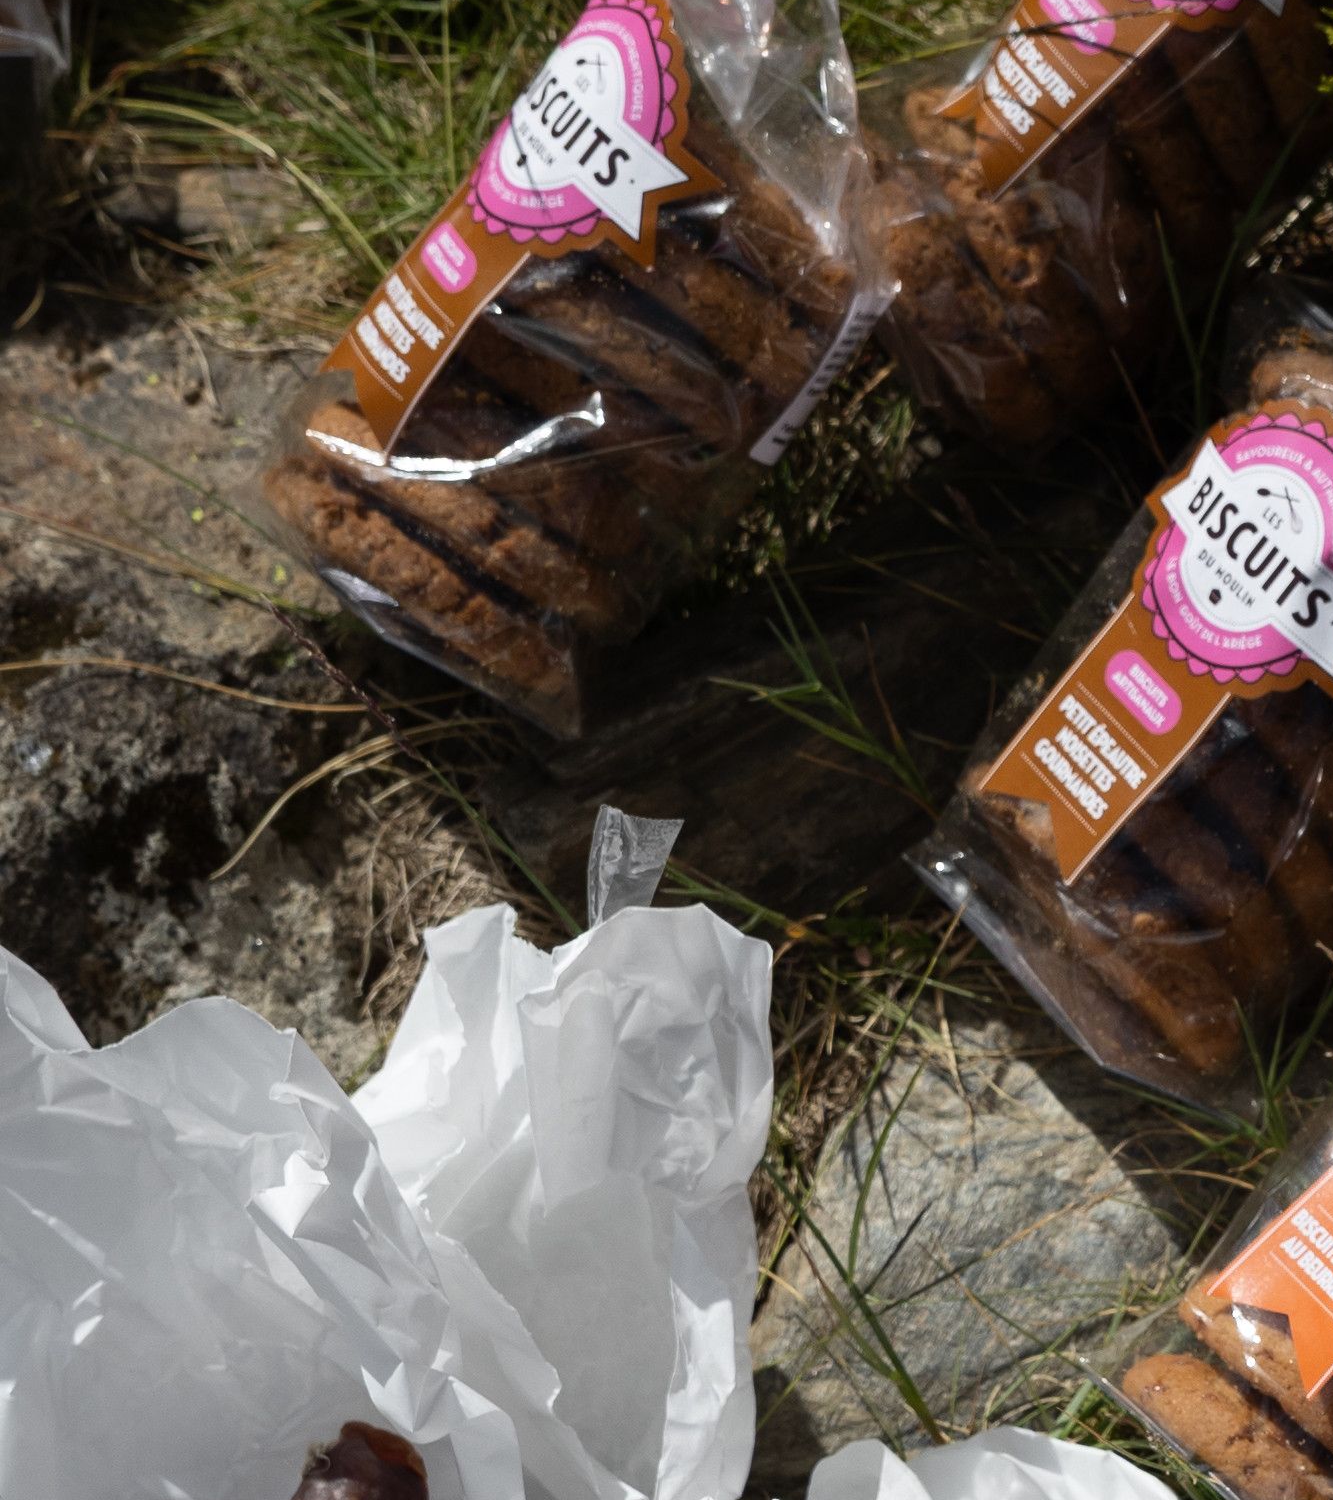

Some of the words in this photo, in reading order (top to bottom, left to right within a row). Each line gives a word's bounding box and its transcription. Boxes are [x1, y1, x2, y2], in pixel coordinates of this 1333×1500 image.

[1263, 507, 1283, 530] LES
[1188, 477, 1331, 627] BISCUITS
[1216, 568, 1256, 607] MOULIN
[1280, 1236, 1301, 1260] AU
